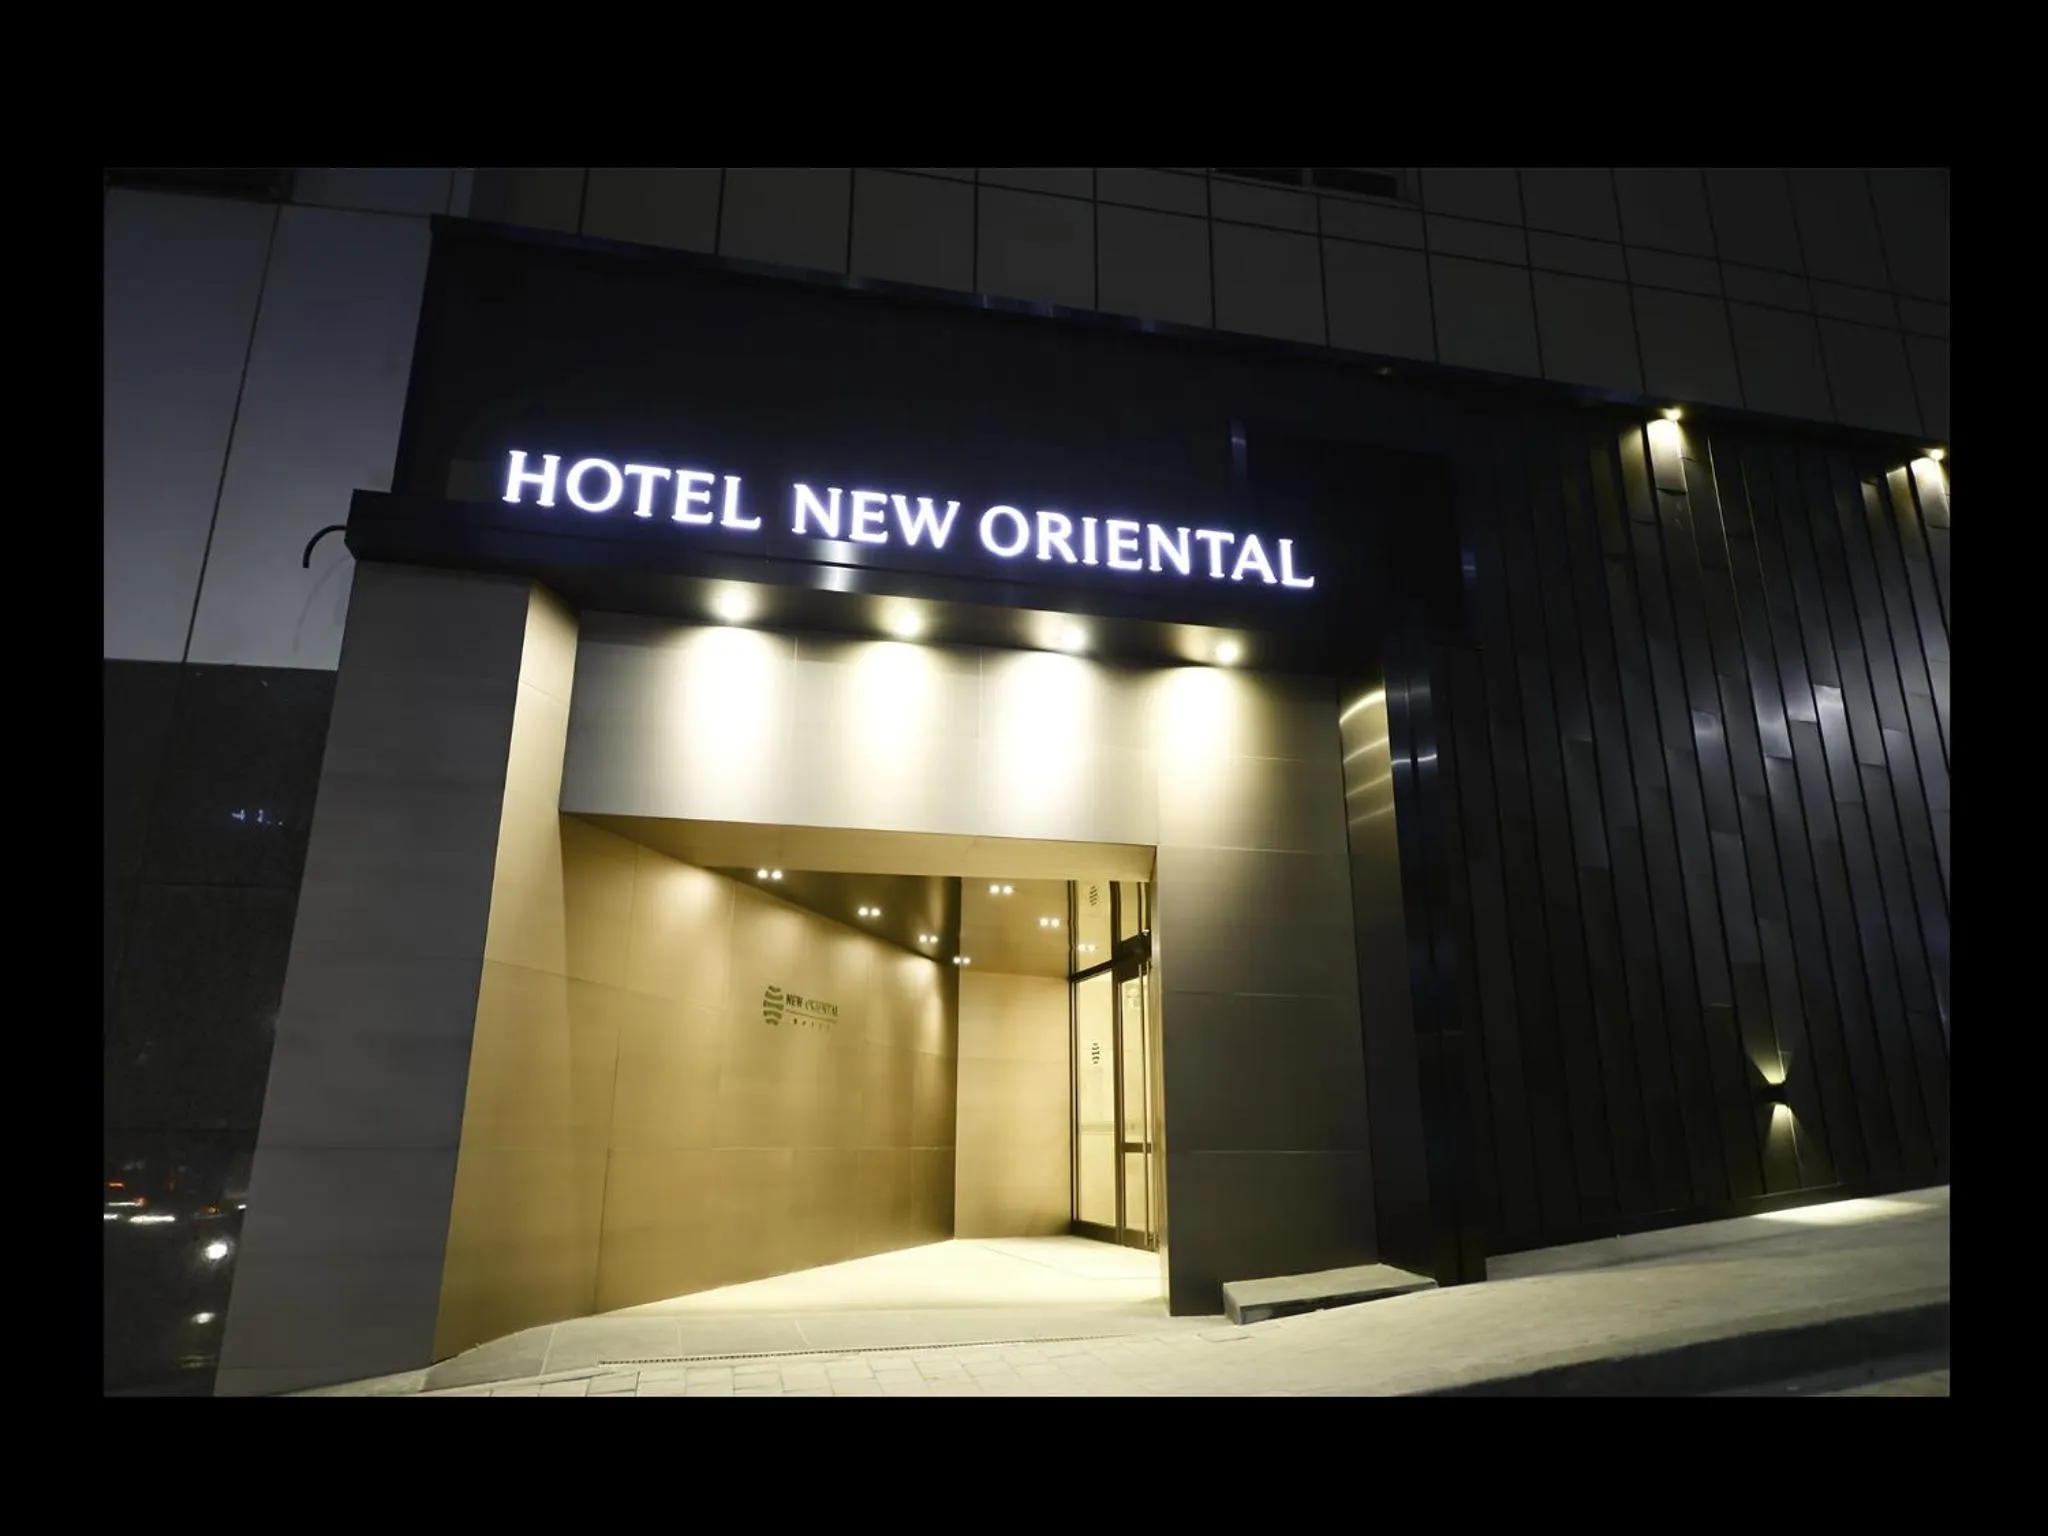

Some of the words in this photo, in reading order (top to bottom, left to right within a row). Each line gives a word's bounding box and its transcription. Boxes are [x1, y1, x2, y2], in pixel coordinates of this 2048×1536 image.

[502, 449, 761, 531] HOTEL
[791, 482, 961, 550] NEW
[979, 505, 1316, 589] ORIENTAL
[786, 993, 803, 1008] NEW
